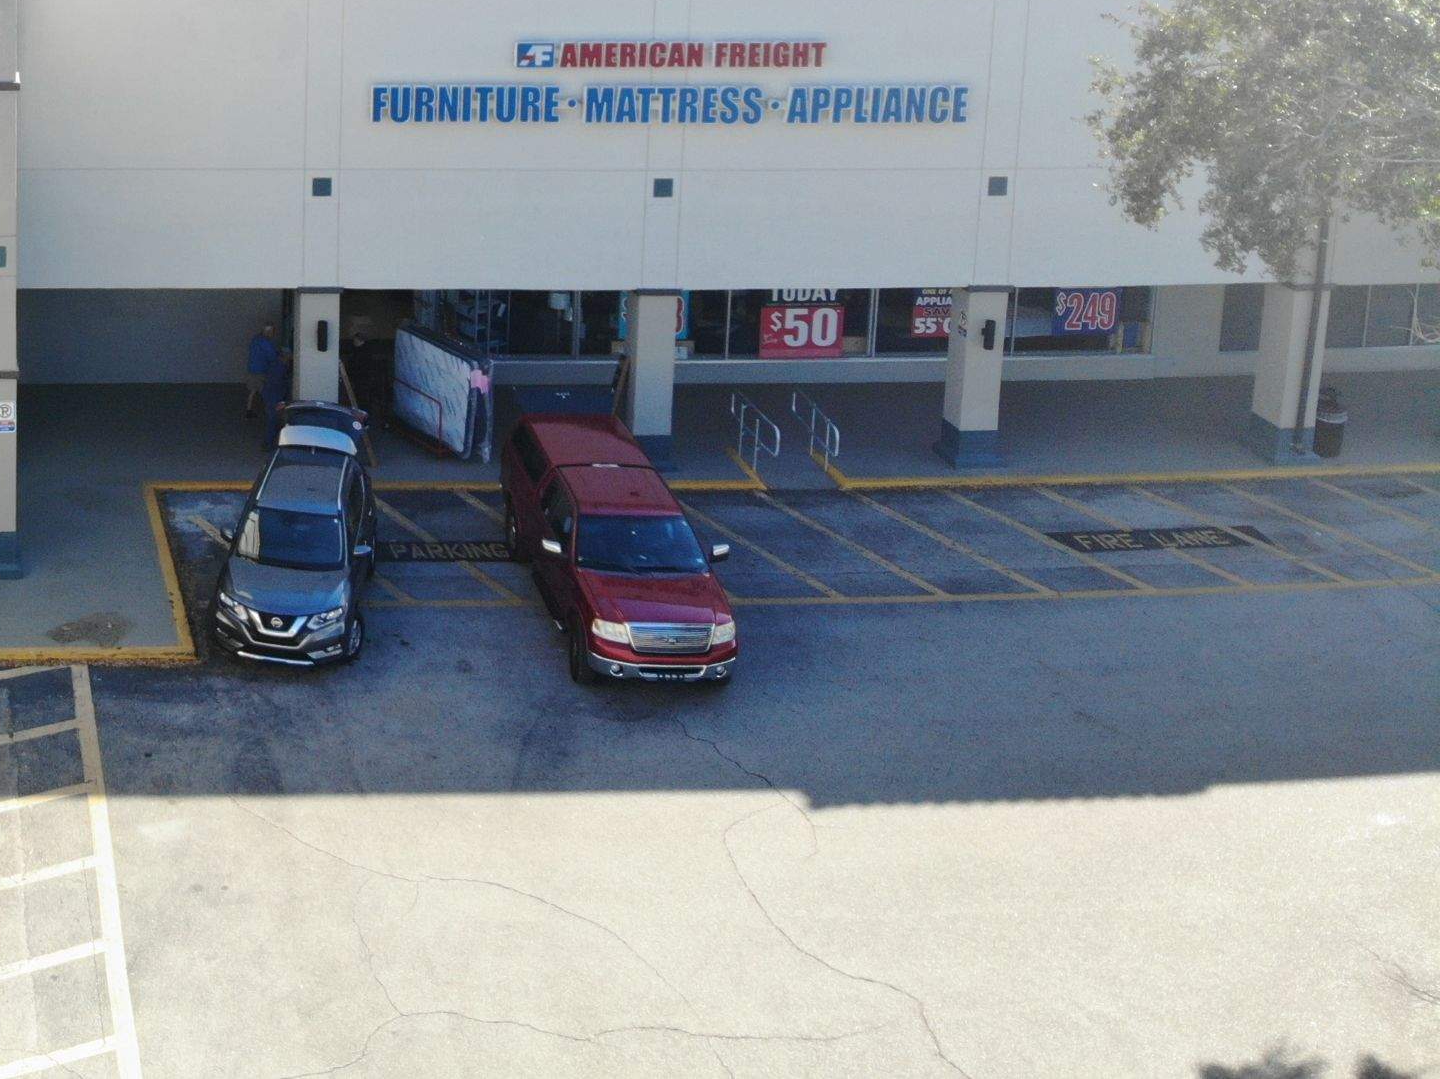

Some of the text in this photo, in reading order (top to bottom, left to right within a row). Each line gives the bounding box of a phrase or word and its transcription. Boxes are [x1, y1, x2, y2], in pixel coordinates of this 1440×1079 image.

[560, 42, 704, 68] AMERICAN
[714, 42, 827, 67] FREIGHT
[372, 85, 969, 124] FURNITURE MATTRESS APPLIANCE
[771, 288, 839, 301] TODAY
[1055, 291, 1117, 331] $249
[388, 538, 511, 559] PARKING
[1073, 529, 1231, 550] FIRE LANE
